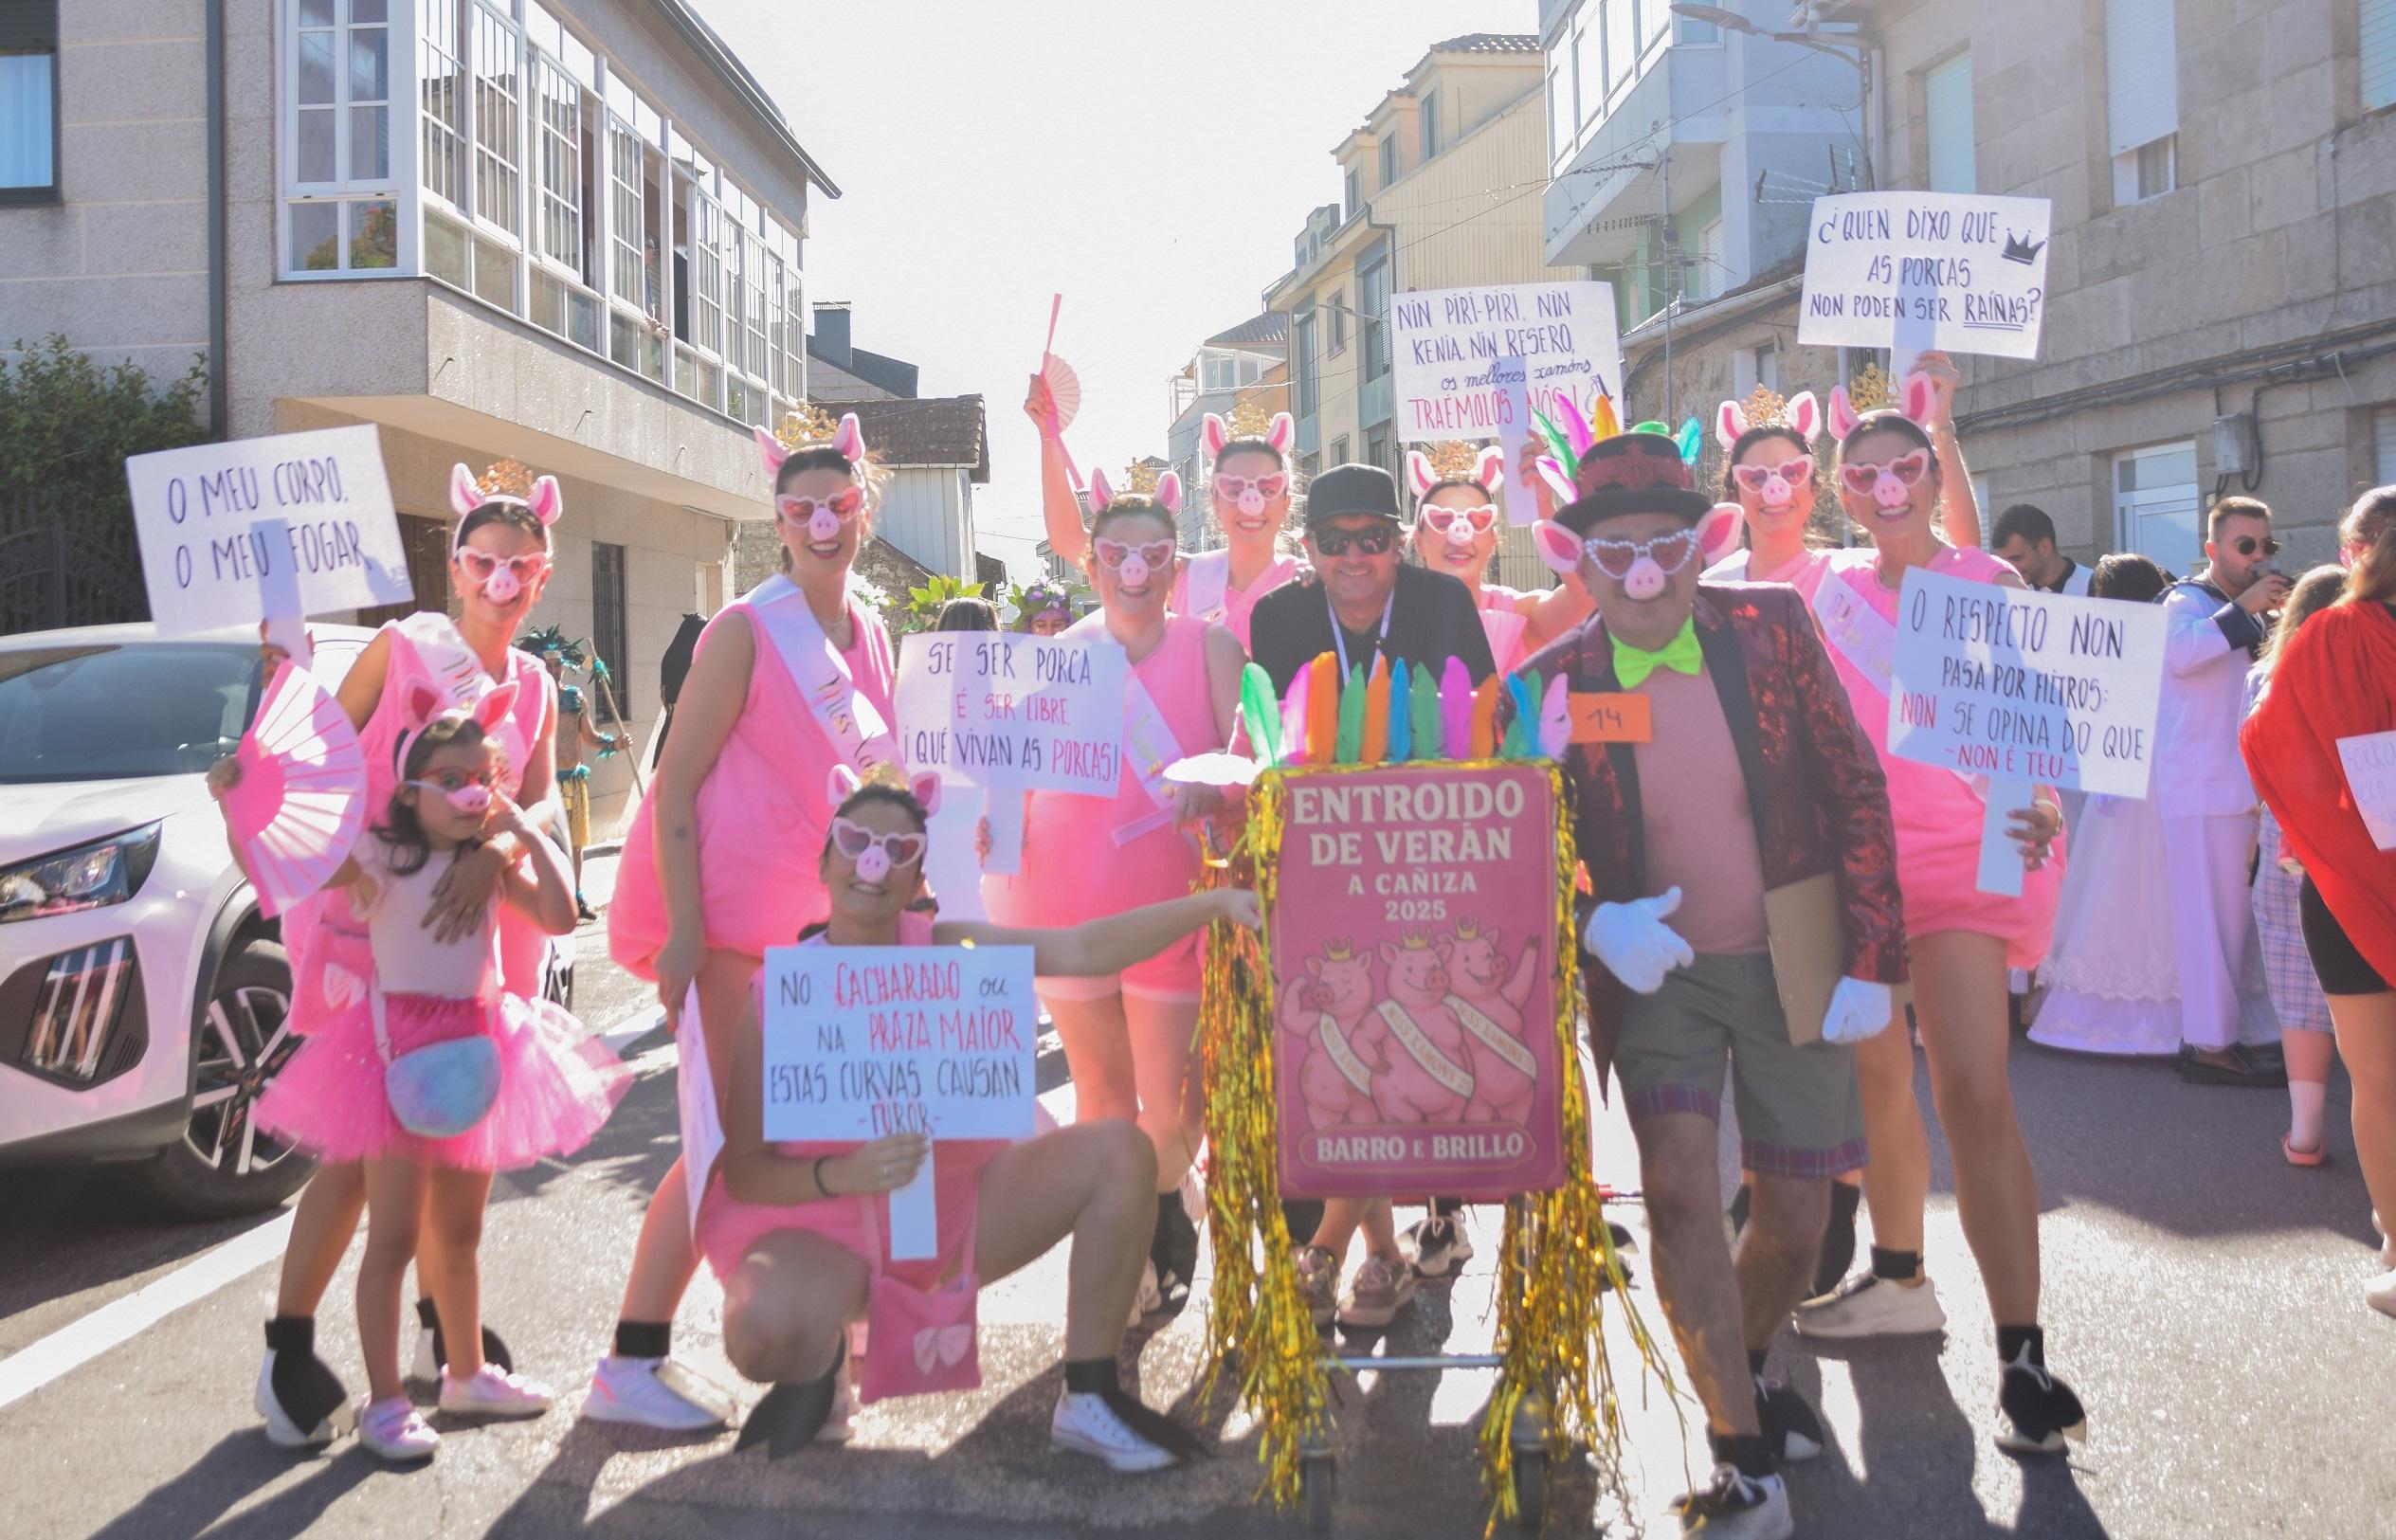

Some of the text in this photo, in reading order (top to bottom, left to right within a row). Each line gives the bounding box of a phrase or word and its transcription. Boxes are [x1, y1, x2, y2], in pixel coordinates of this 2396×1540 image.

[1818, 206, 1999, 245] ¿QUEN DIXO QUE
[1867, 254, 1971, 288] AS PORCAS
[1397, 299, 1432, 331] NIN
[1537, 290, 1571, 318] NIN
[1810, 292, 1843, 318] NON
[1853, 294, 1906, 318] PODEN
[1915, 296, 1951, 322] SER
[1469, 331, 1498, 360] NIN
[1441, 377, 1458, 391] os
[1464, 361, 1526, 389] mellores
[1407, 389, 1514, 429] TRAÉMOLOS
[168, 478, 187, 524] O
[200, 467, 259, 516] MEU
[175, 520, 372, 589] O MEU FOGAR
[1911, 589, 1927, 632] O
[1943, 594, 2047, 653] RESPECTO
[2070, 612, 2124, 659] NON
[928, 642, 1092, 686] SE SER PORCA
[1942, 656, 1986, 692] PASA
[1992, 664, 2025, 699] POR
[956, 688, 968, 718] É
[984, 693, 1016, 721] SER
[1587, 707, 1622, 730] 14
[1900, 691, 2144, 761] NON SE OPINA DO QUE
[955, 727, 1012, 766] VIVAN
[1022, 736, 1042, 771] AS
[1052, 738, 1118, 782] PORCAS!
[2006, 746, 2015, 772] É
[1292, 779, 1524, 824] ENTROIDO
[1310, 822, 1513, 865] DE VERÁN
[1348, 867, 1478, 896] A CAÑIZA
[1385, 900, 1446, 922] 2025
[780, 961, 1009, 1008] NO CACHARADO ou
[817, 1024, 846, 1053] NA
[868, 1007, 931, 1053] PRAZA
[771, 1055, 1022, 1104] ESTAS CURVAS CAUSAN
[1317, 1132, 1524, 1162] BARRO E BRILLO
